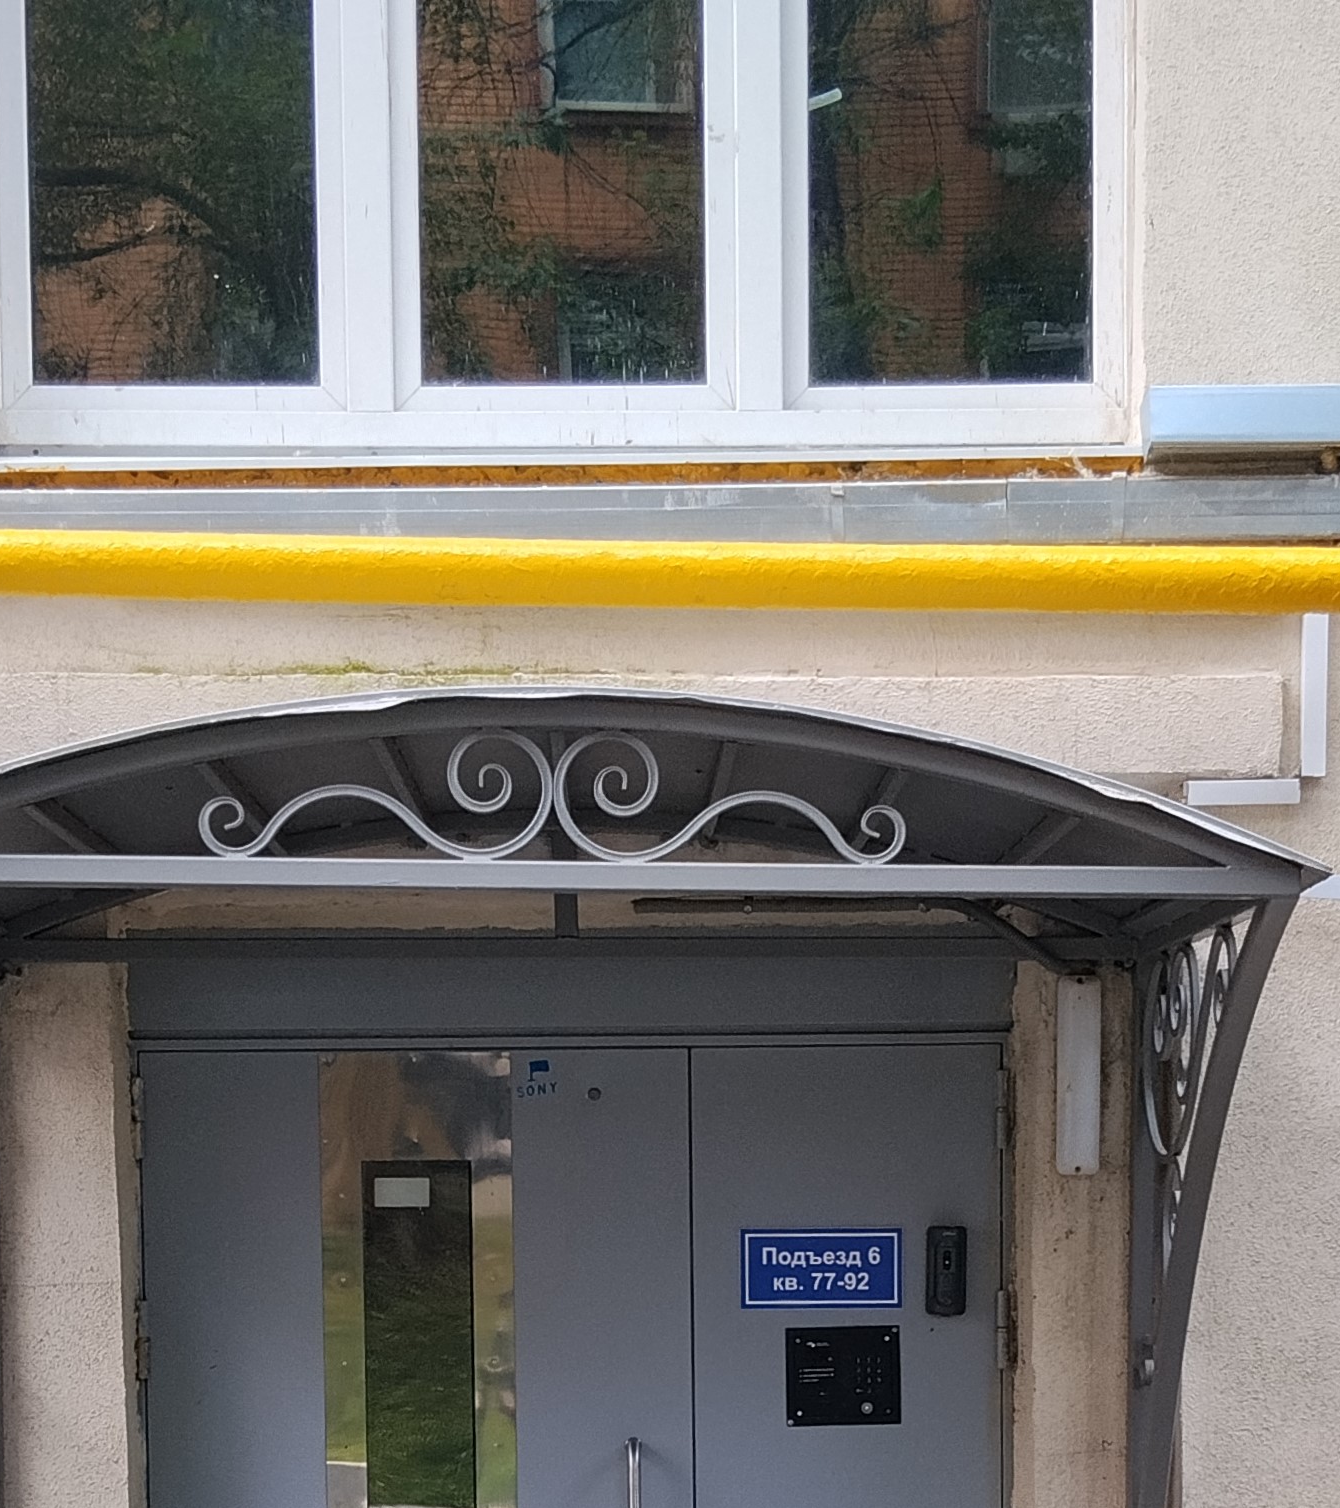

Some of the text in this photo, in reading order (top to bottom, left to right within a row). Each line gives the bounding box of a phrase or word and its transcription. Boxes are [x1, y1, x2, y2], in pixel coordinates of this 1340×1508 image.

[762, 1246, 881, 1268] Подъезд 6
[773, 1272, 870, 1291] кв. 77-92
